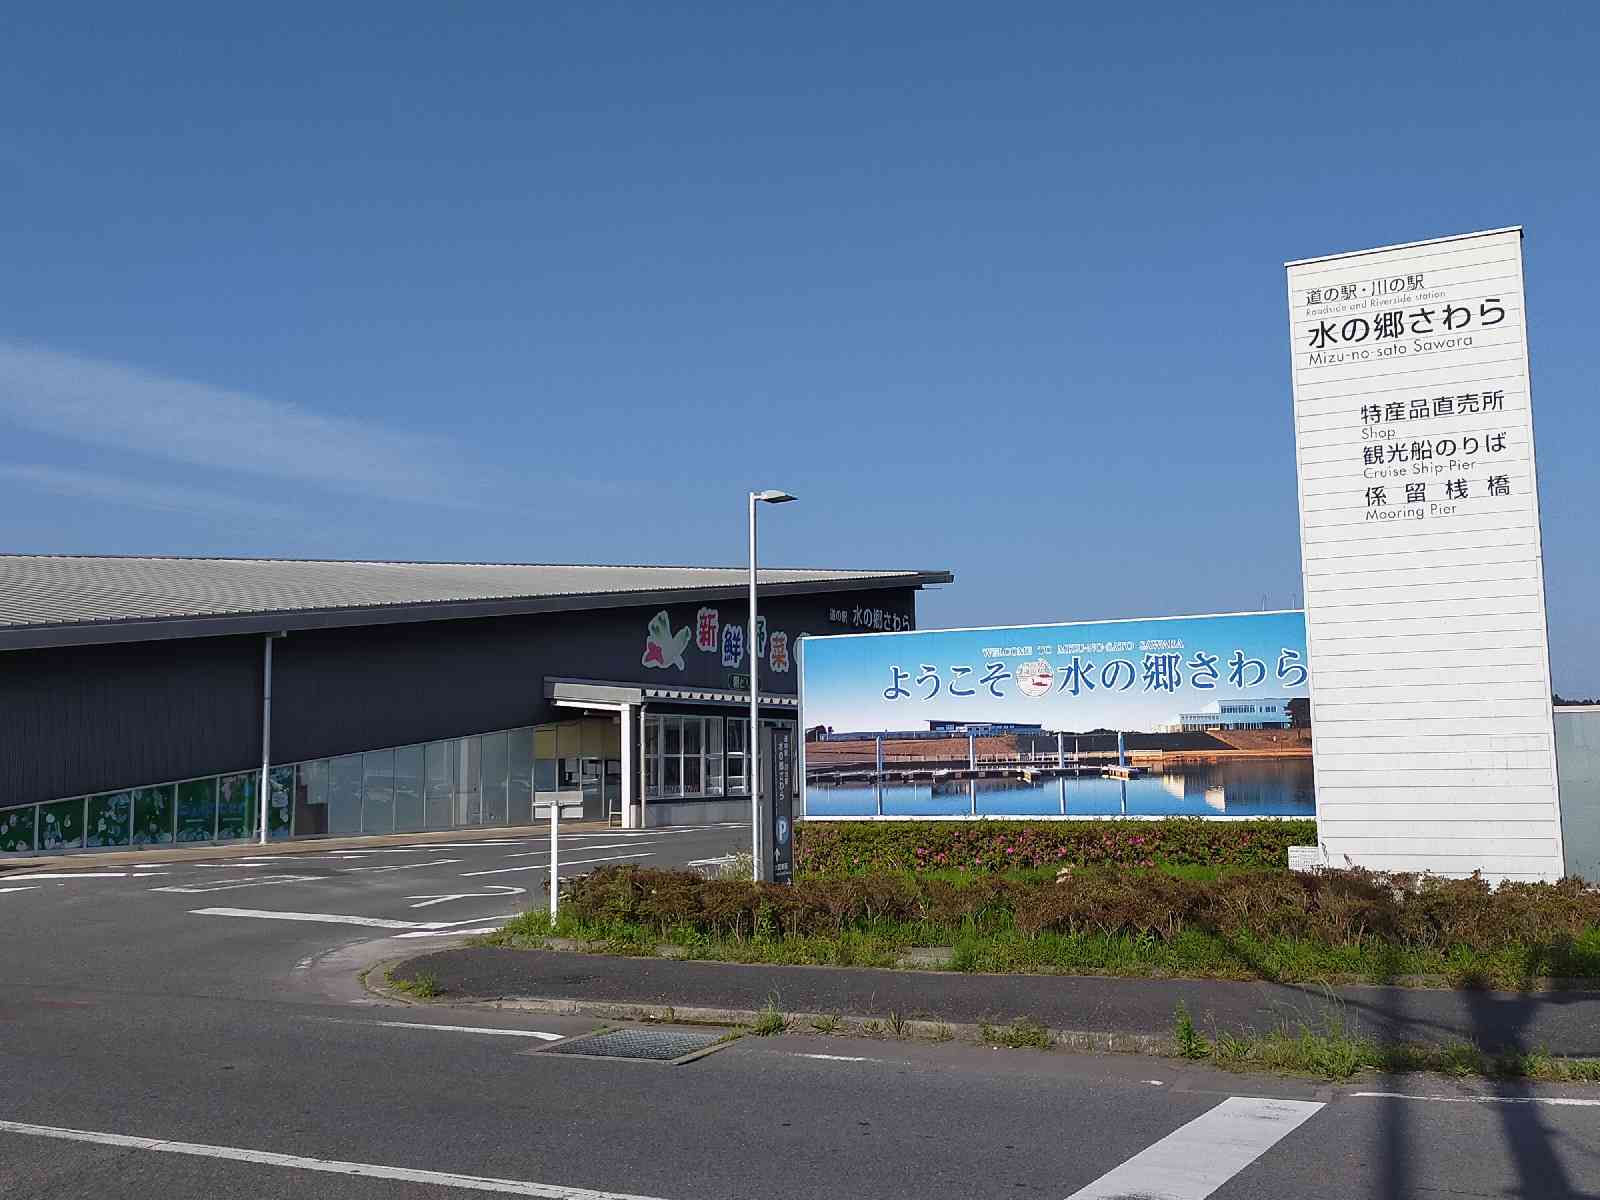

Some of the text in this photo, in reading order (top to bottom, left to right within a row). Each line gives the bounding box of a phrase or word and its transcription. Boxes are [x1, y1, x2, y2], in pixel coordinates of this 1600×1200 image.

[1306, 274, 1425, 306] 道の駅・川の駅
[1350, 300, 1367, 311] and
[1308, 298, 1506, 349] 水の郷さわら
[1308, 335, 1473, 366] Mizu-no-sato Sawara
[1360, 390, 1505, 425] 特産品直売所
[1361, 427, 1396, 441] Shop
[1363, 432, 1507, 466] 観光船のりば
[1363, 459, 1477, 480] Cruise Ship Pier
[1365, 474, 1511, 507] 係留桟橋
[1365, 503, 1457, 521] Mooring Pier
[882, 648, 1308, 702] ようこそ 水の郷さわら
